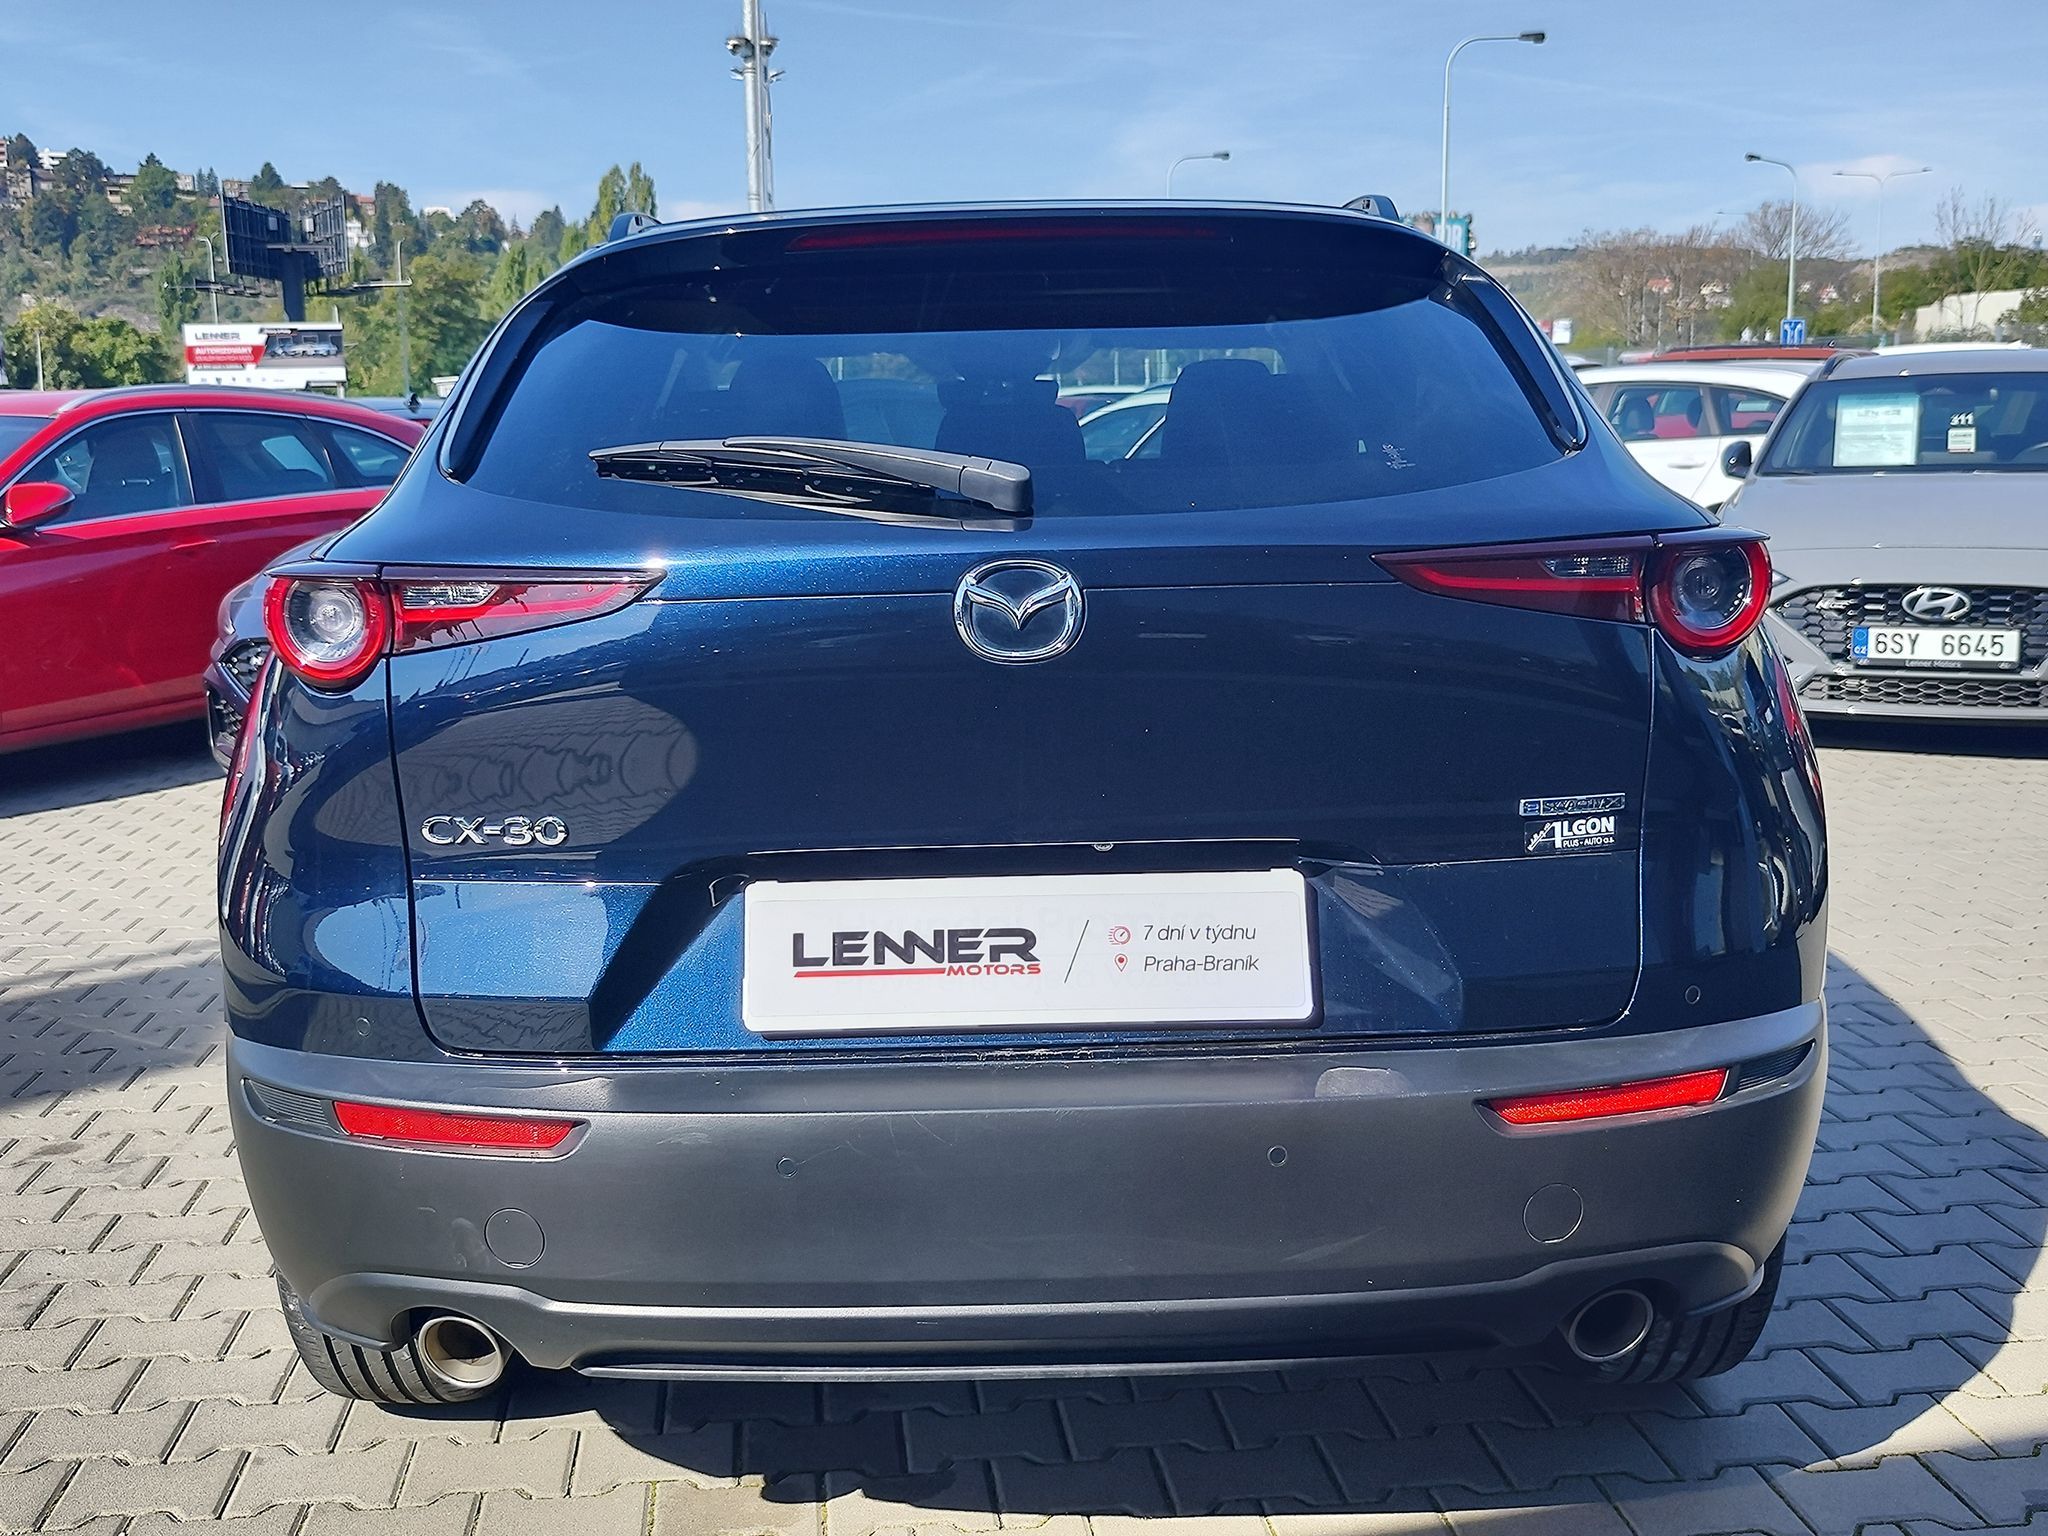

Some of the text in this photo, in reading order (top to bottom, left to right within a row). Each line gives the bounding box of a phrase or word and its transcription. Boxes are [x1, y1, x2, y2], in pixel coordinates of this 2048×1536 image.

[1875, 632, 1920, 655] 6SY
[1941, 634, 2005, 656] 6645
[421, 814, 569, 846] CX-30
[1143, 924, 1256, 945] 7 dní v týdnu
[792, 928, 1040, 967] LENNER
[946, 962, 1041, 977] MOTORS
[1143, 953, 1260, 973] Praha-Braník
